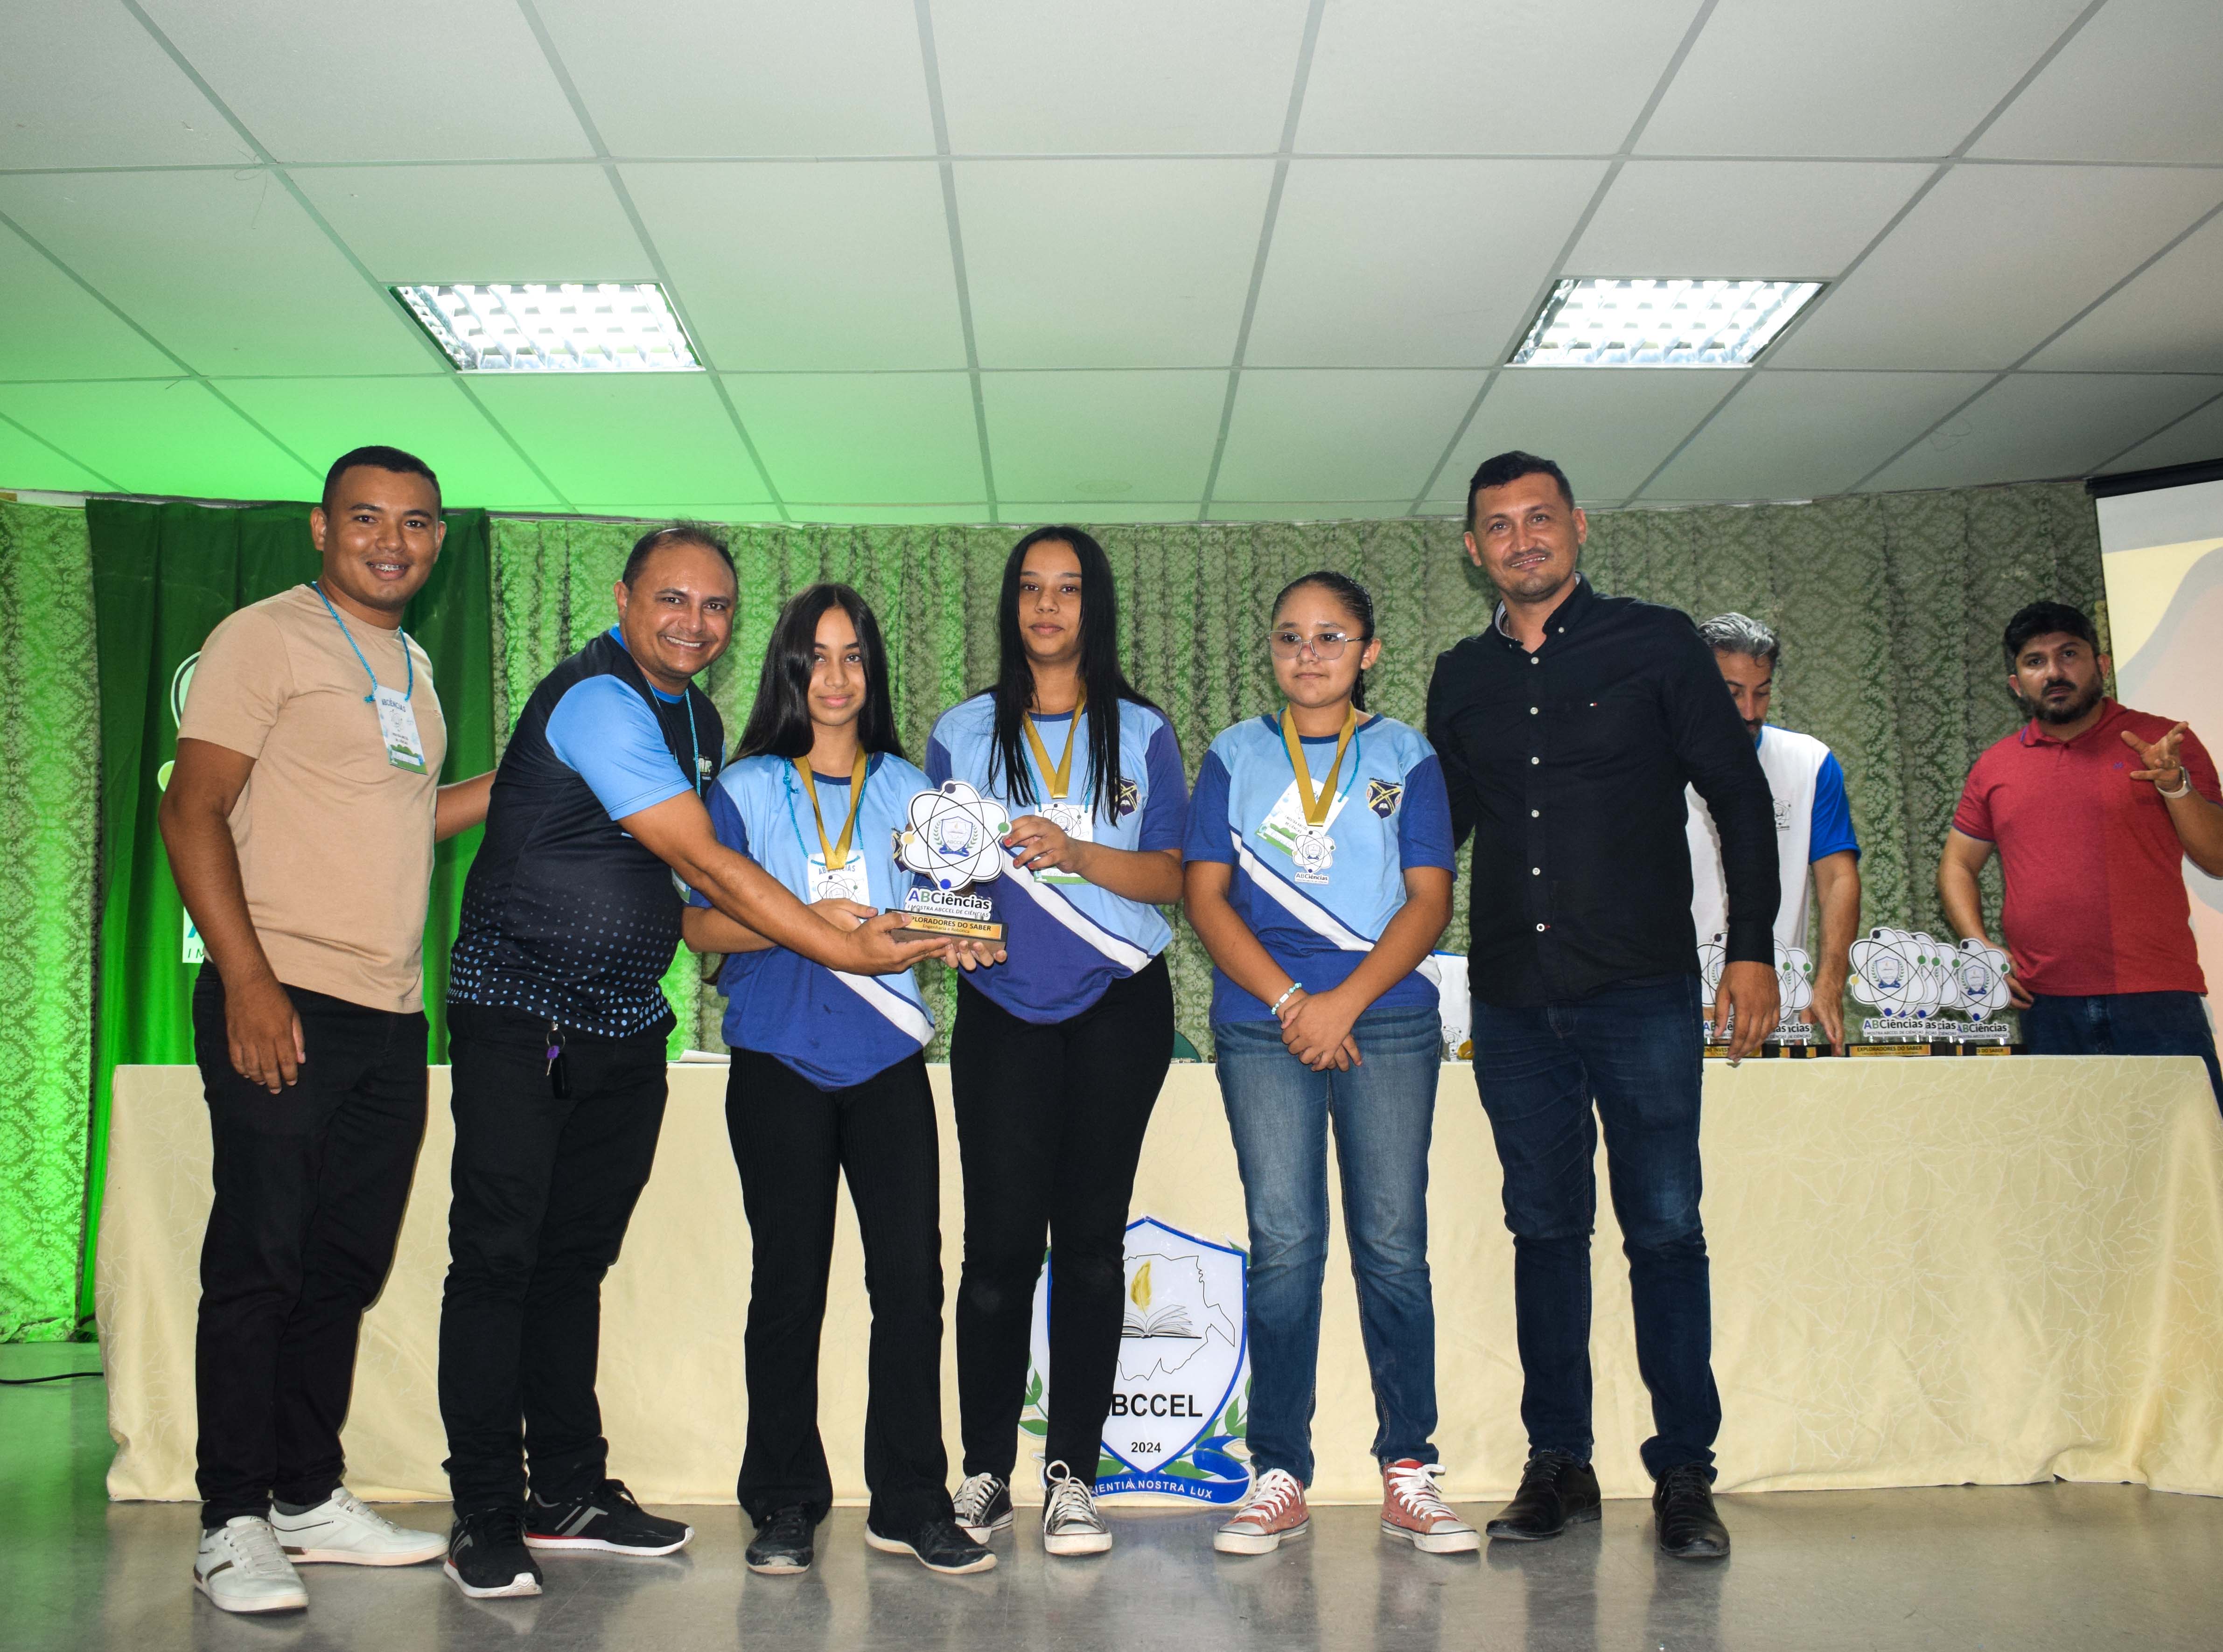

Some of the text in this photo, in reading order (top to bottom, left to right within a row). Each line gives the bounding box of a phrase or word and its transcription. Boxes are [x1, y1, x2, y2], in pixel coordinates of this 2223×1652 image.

[908, 888, 990, 910] ABCiências
[1864, 1018, 1923, 1029] ABCiências
[1957, 1023, 2006, 1033] ABCiências
[1111, 1393, 1203, 1417] BCCEL
[1131, 1442, 1161, 1453] 2024
[1095, 1480, 1213, 1499] IENTIA NOSTRA LUX
